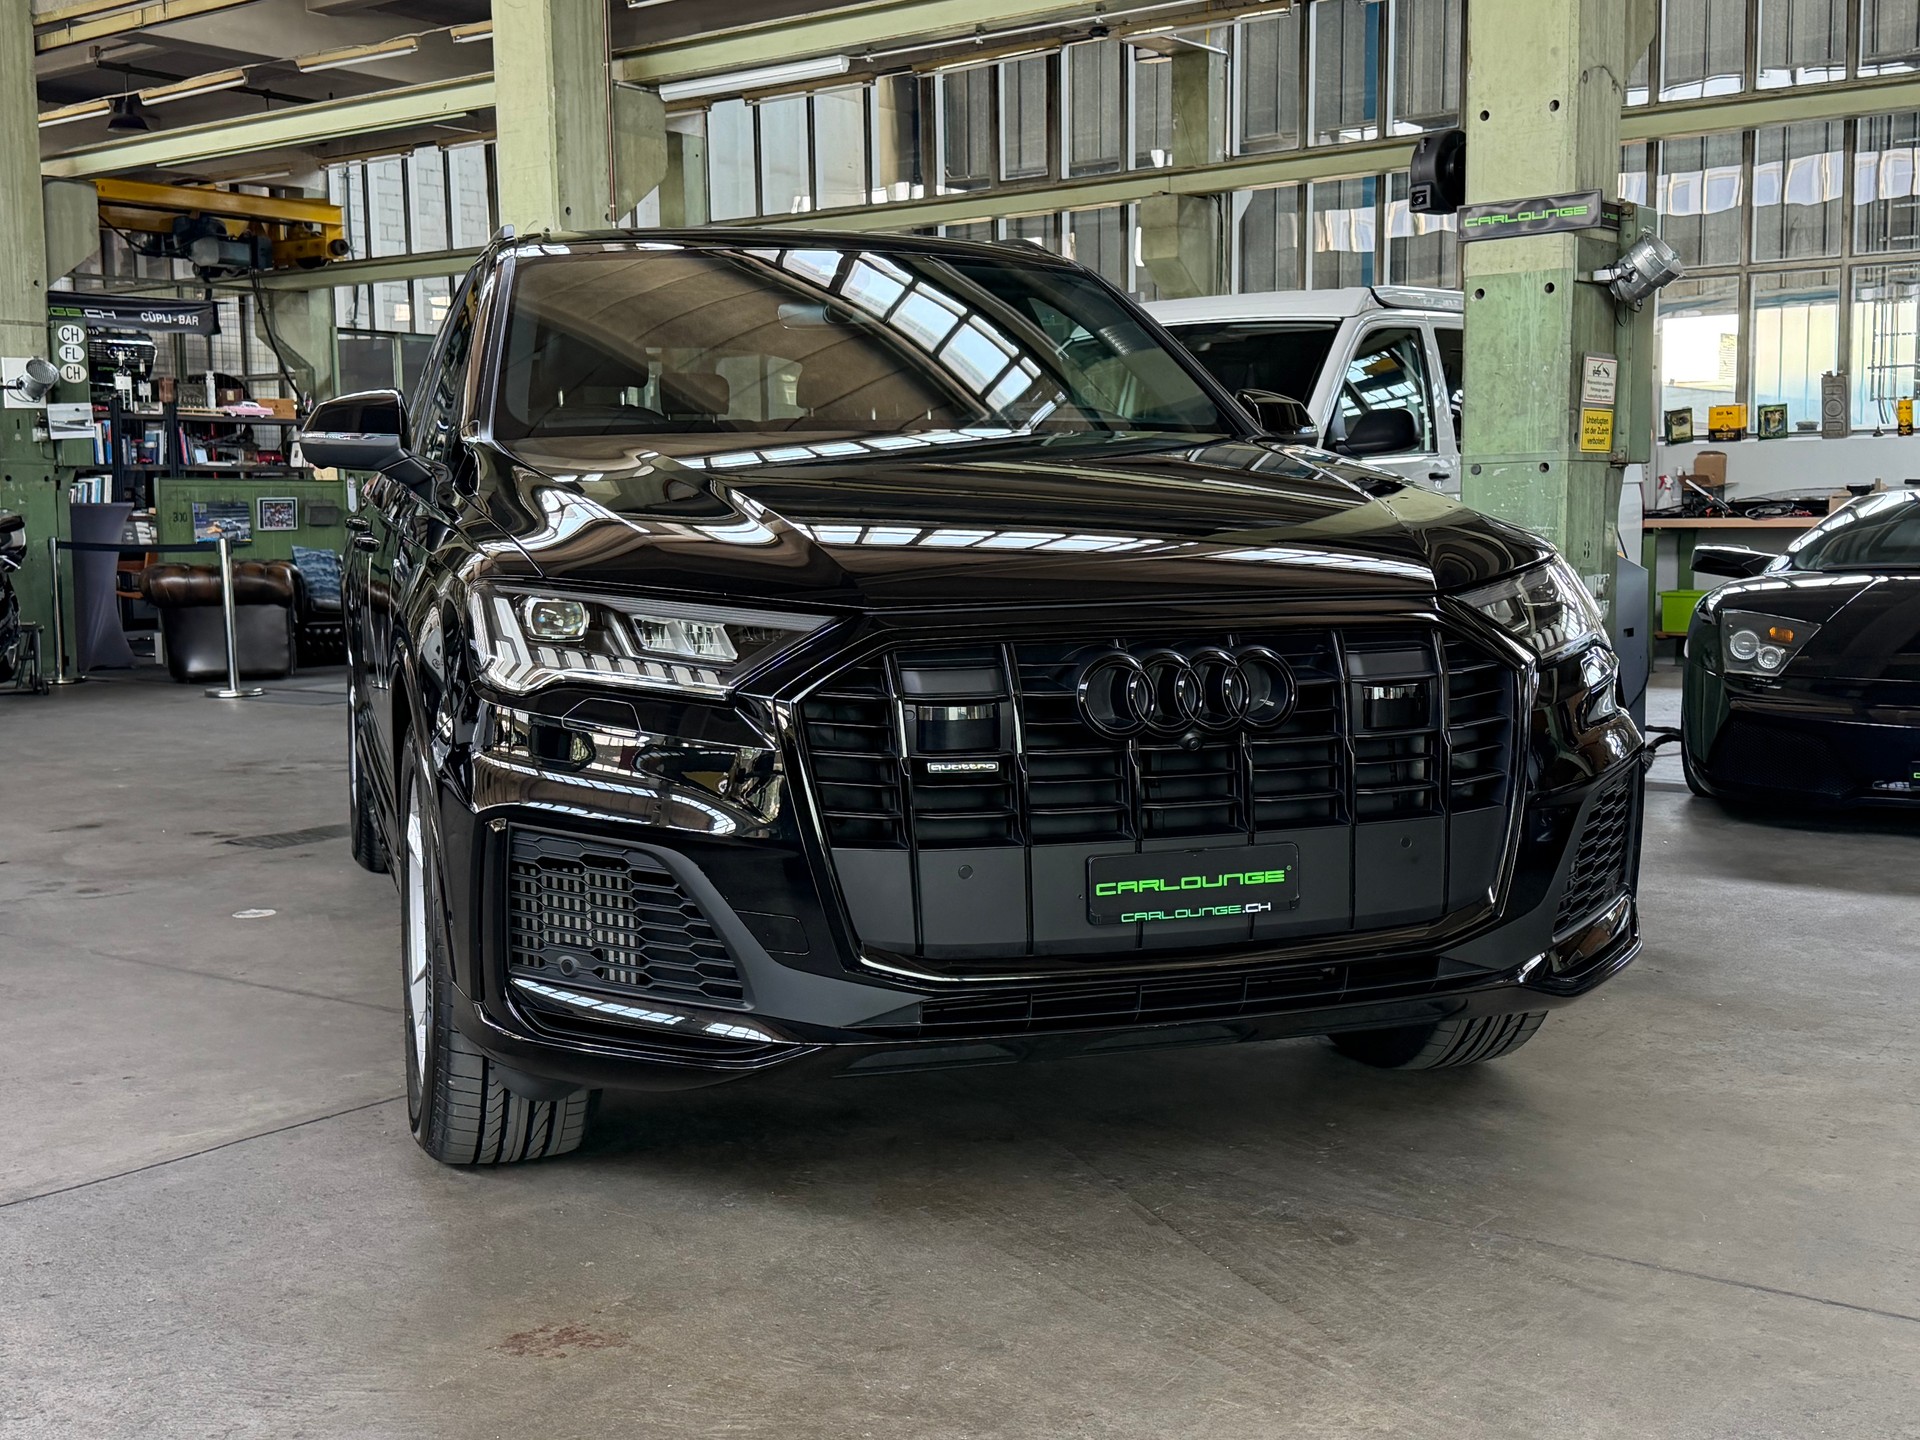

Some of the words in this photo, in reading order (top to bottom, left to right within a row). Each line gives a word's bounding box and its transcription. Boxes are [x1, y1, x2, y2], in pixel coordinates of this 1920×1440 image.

[1464, 205, 1588, 228] CARLOUNGE
[61, 327, 80, 342] CH
[65, 346, 79, 360] FL
[66, 365, 81, 380] CH
[930, 763, 996, 772] quattro
[1095, 869, 1285, 896] CARLOUNGE
[1121, 902, 1271, 923] CARLOUNGE.CH
